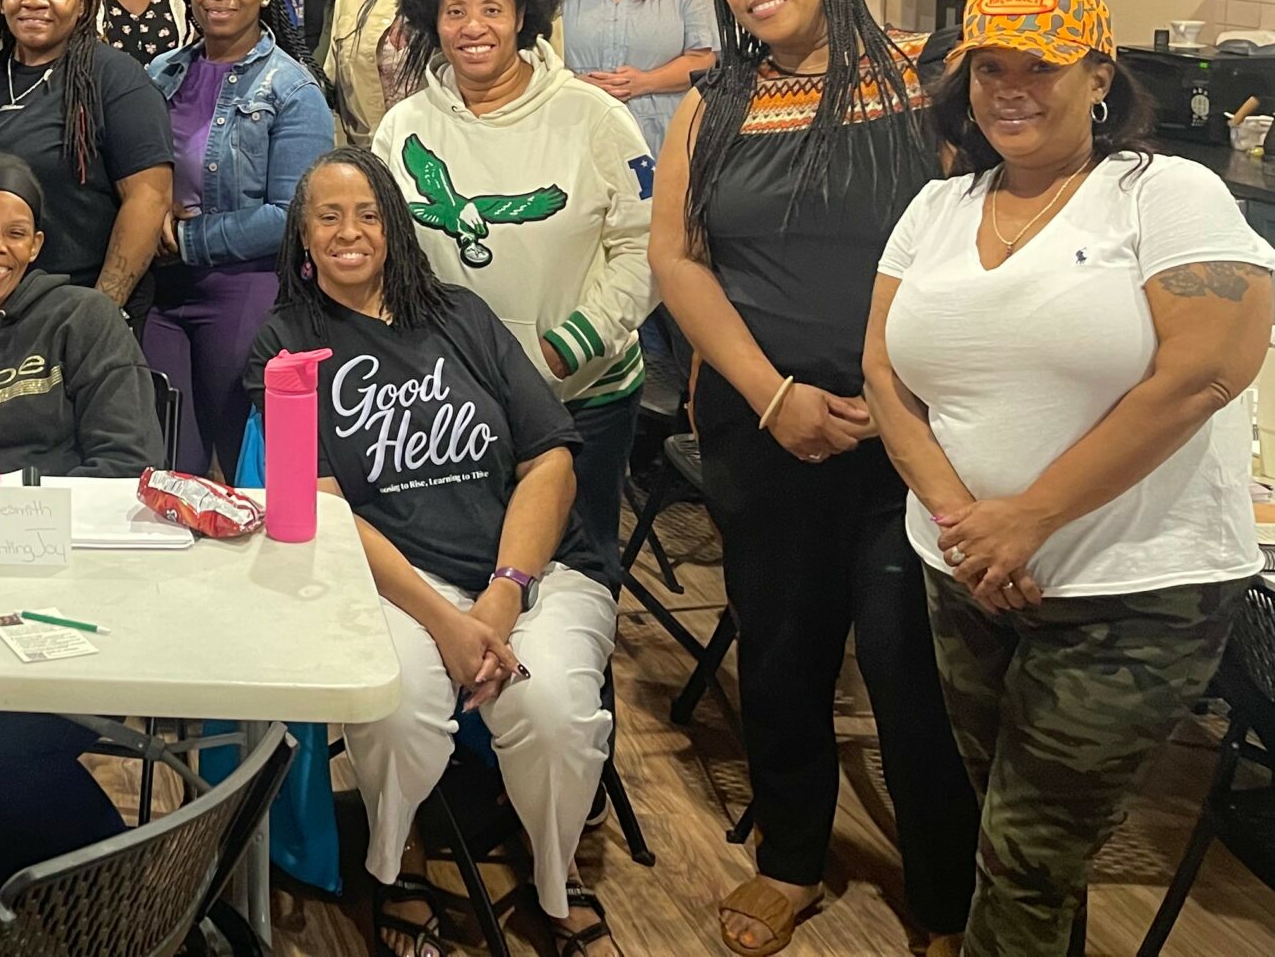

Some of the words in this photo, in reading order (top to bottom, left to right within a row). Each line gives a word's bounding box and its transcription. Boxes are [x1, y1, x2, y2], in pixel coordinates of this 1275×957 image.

[332, 354, 450, 438] Good
[365, 401, 498, 483] Hello
[409, 480, 428, 489] Rise,
[428, 474, 462, 486] Learning
[461, 473, 471, 481] to
[25, 528, 67, 564] Joy
